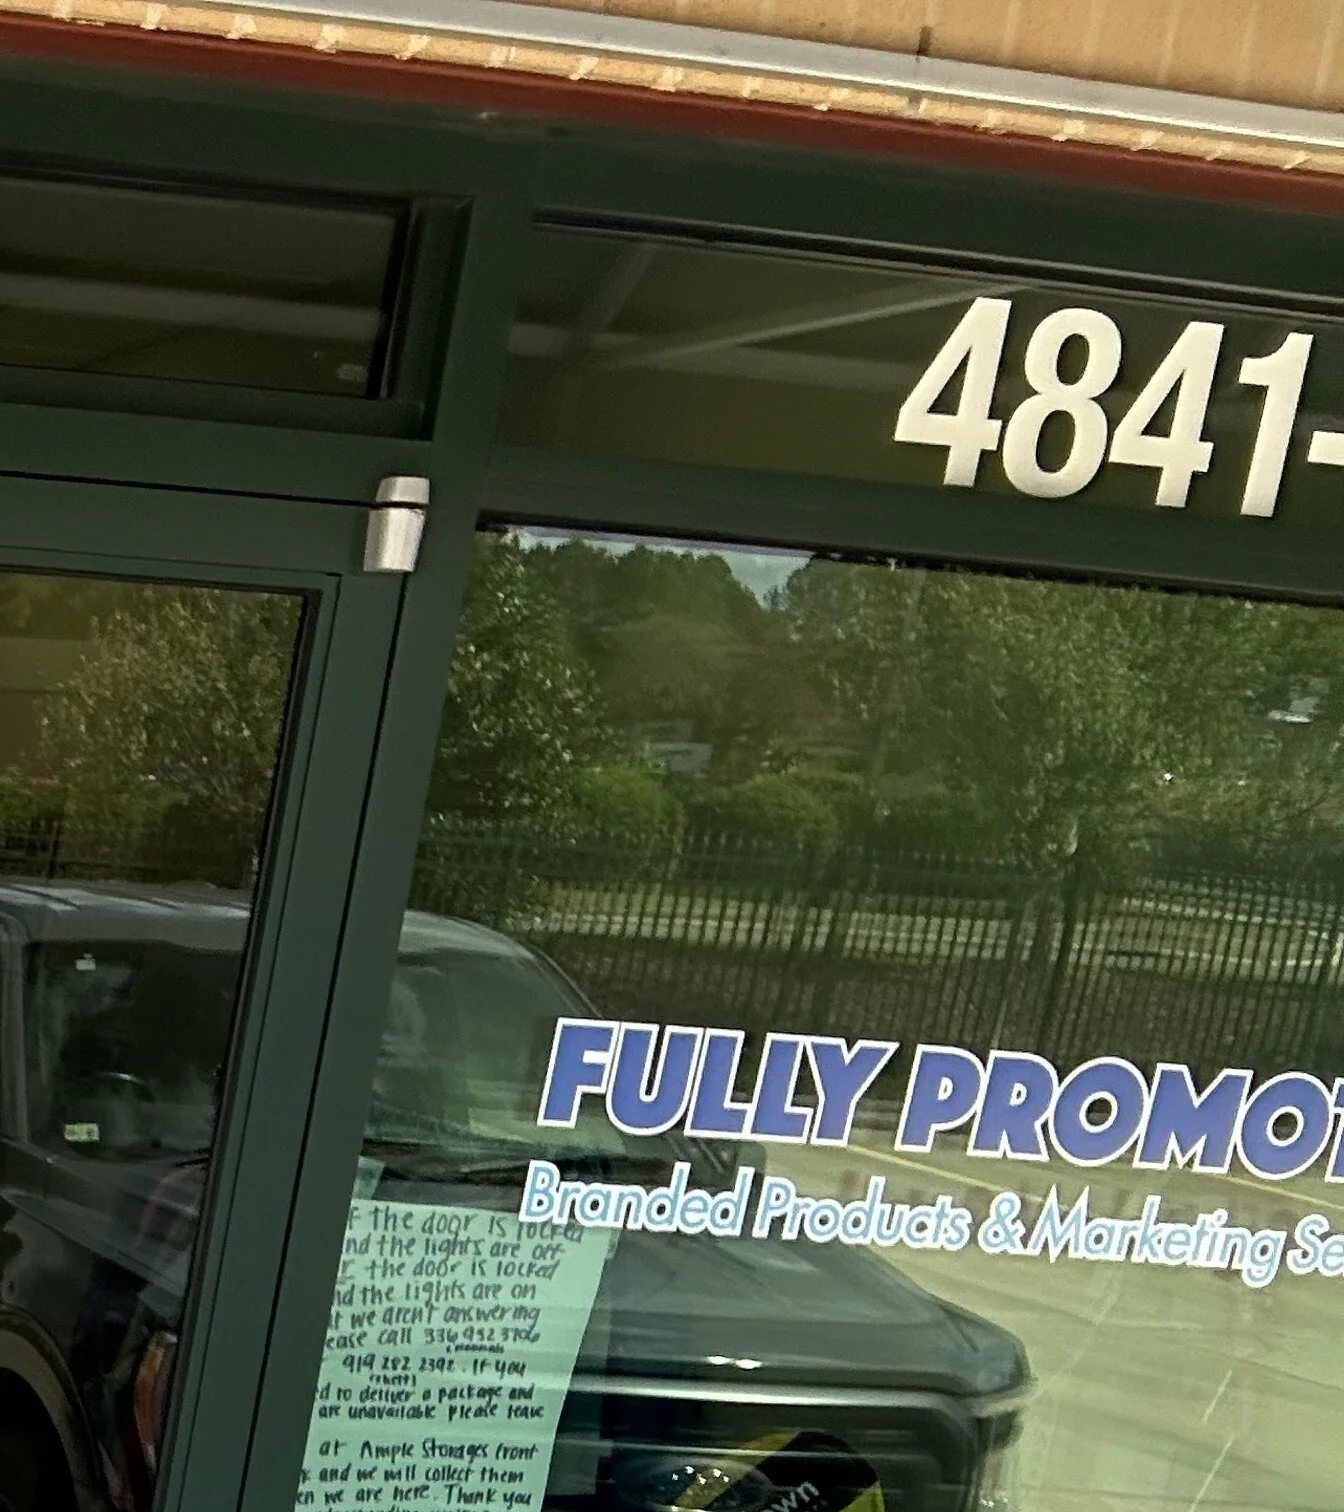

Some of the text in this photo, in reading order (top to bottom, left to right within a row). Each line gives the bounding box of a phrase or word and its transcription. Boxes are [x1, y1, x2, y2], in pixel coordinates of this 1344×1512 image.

[893, 297, 1344, 518] 4841-
[537, 1016, 1344, 1182] FULLY PROMO
[372, 1205, 413, 1231] the
[422, 1212, 478, 1235] door
[518, 1159, 755, 1237] Branded
[752, 1166, 972, 1253] Products
[979, 1199, 1033, 1253] &
[1028, 1183, 1287, 1289] Marketing
[377, 1234, 416, 1257] the
[424, 1231, 485, 1262] lights
[490, 1241, 521, 1258] are
[369, 1258, 406, 1280] the
[412, 1257, 462, 1278] door
[496, 1259, 561, 1281] locked
[360, 1283, 395, 1306] the
[405, 1281, 465, 1307] lights
[472, 1284, 503, 1301] are
[510, 1283, 537, 1301] on
[351, 1309, 376, 1329] we
[378, 1327, 412, 1349] call
[342, 1352, 376, 1374] 919
[495, 1359, 527, 1379] you
[336, 1386, 353, 1401] to
[359, 1385, 414, 1404] deliver
[438, 1385, 503, 1406] package
[508, 1382, 535, 1401] and
[318, 1404, 342, 1419] are
[318, 1439, 348, 1457] at
[360, 1439, 415, 1465] Ample
[318, 1463, 353, 1482] and
[356, 1465, 379, 1482] we
[383, 1464, 417, 1482] will
[424, 1464, 475, 1483] collect
[480, 1466, 525, 1483] them
[324, 1488, 345, 1506] we
[355, 1486, 384, 1503] are
[444, 1483, 499, 1505] Thank
[502, 1491, 533, 1511] you
